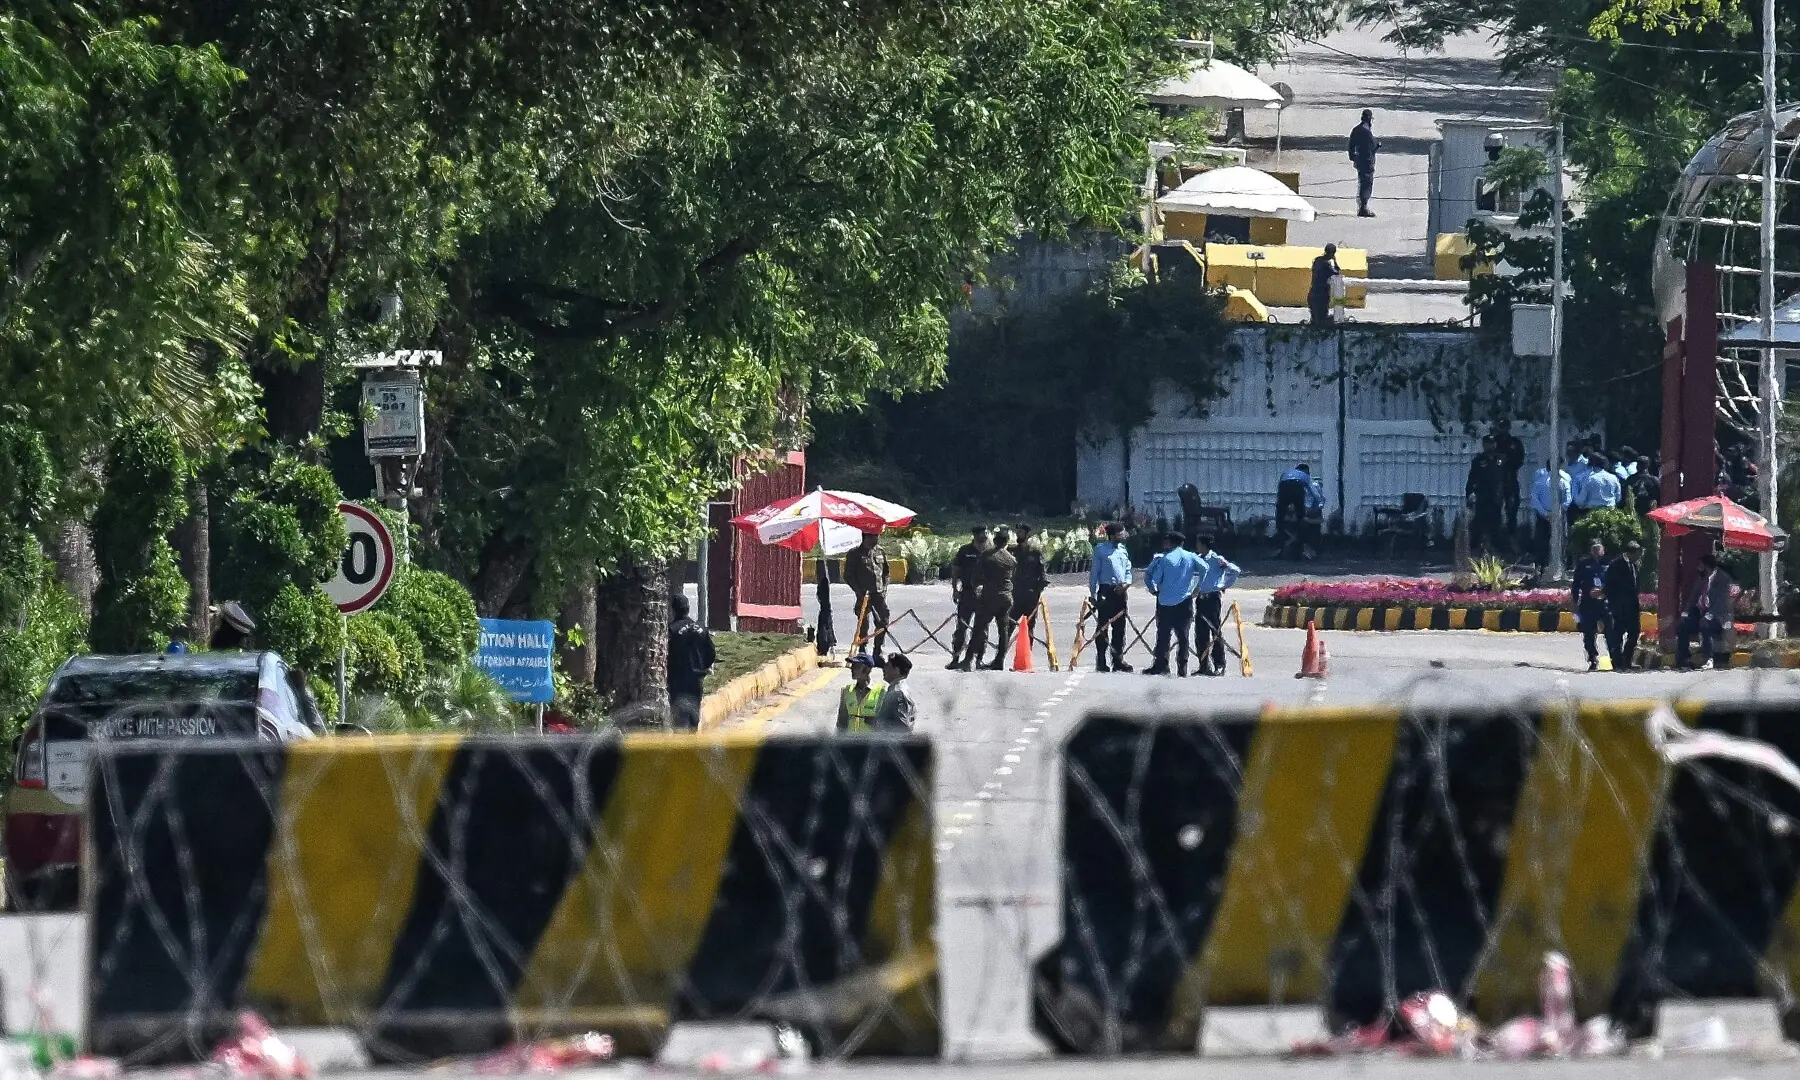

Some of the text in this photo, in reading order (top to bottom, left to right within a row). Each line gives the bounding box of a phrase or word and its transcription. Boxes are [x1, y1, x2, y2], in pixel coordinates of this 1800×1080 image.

[518, 633, 549, 649] HALL
[483, 655, 515, 668] FOREIGN
[516, 656, 548, 668] AFFAIRS
[135, 718, 165, 735] WITH
[167, 717, 216, 735] PASSION
